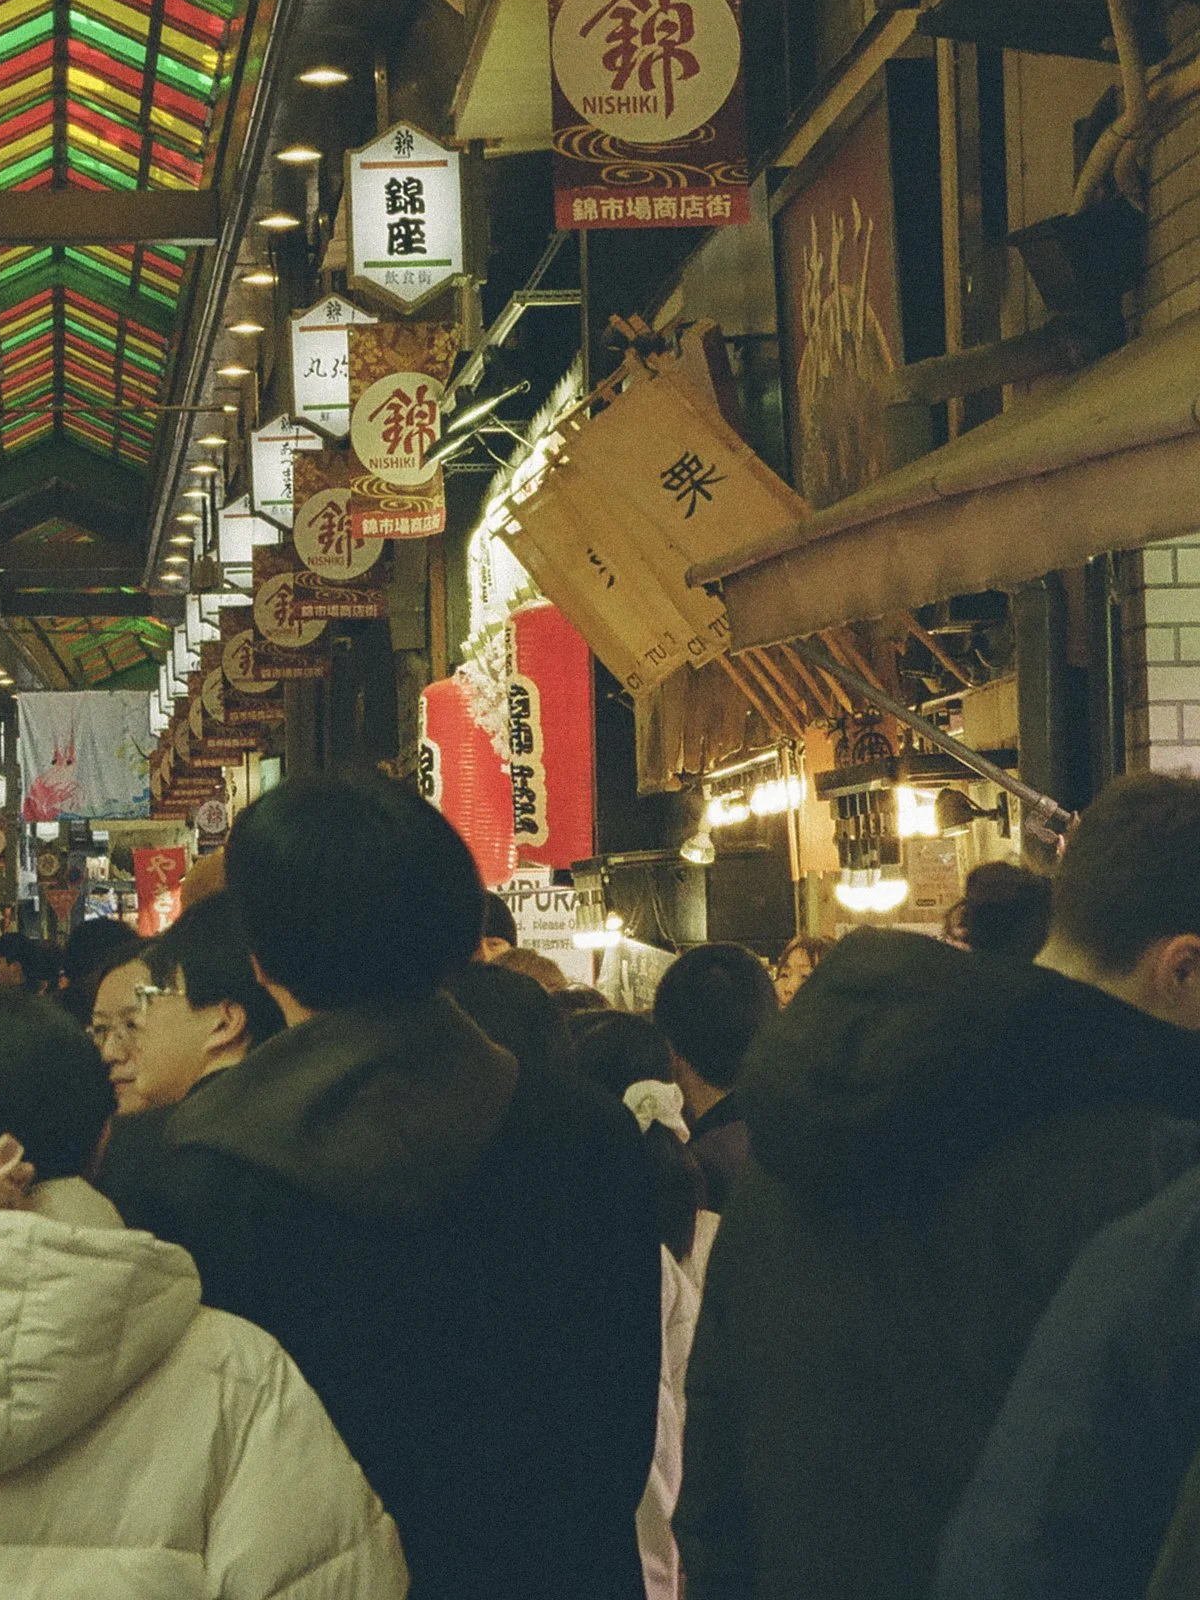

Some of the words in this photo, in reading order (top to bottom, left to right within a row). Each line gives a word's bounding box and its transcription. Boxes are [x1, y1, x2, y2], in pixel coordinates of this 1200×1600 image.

[582, 95, 658, 115] NISHIKI
[384, 176, 427, 256] 錦座
[572, 194, 732, 222] 錦市場商店街
[368, 384, 437, 470] 錦
[368, 456, 415, 469] NISHIKI
[660, 451, 728, 519] 栗
